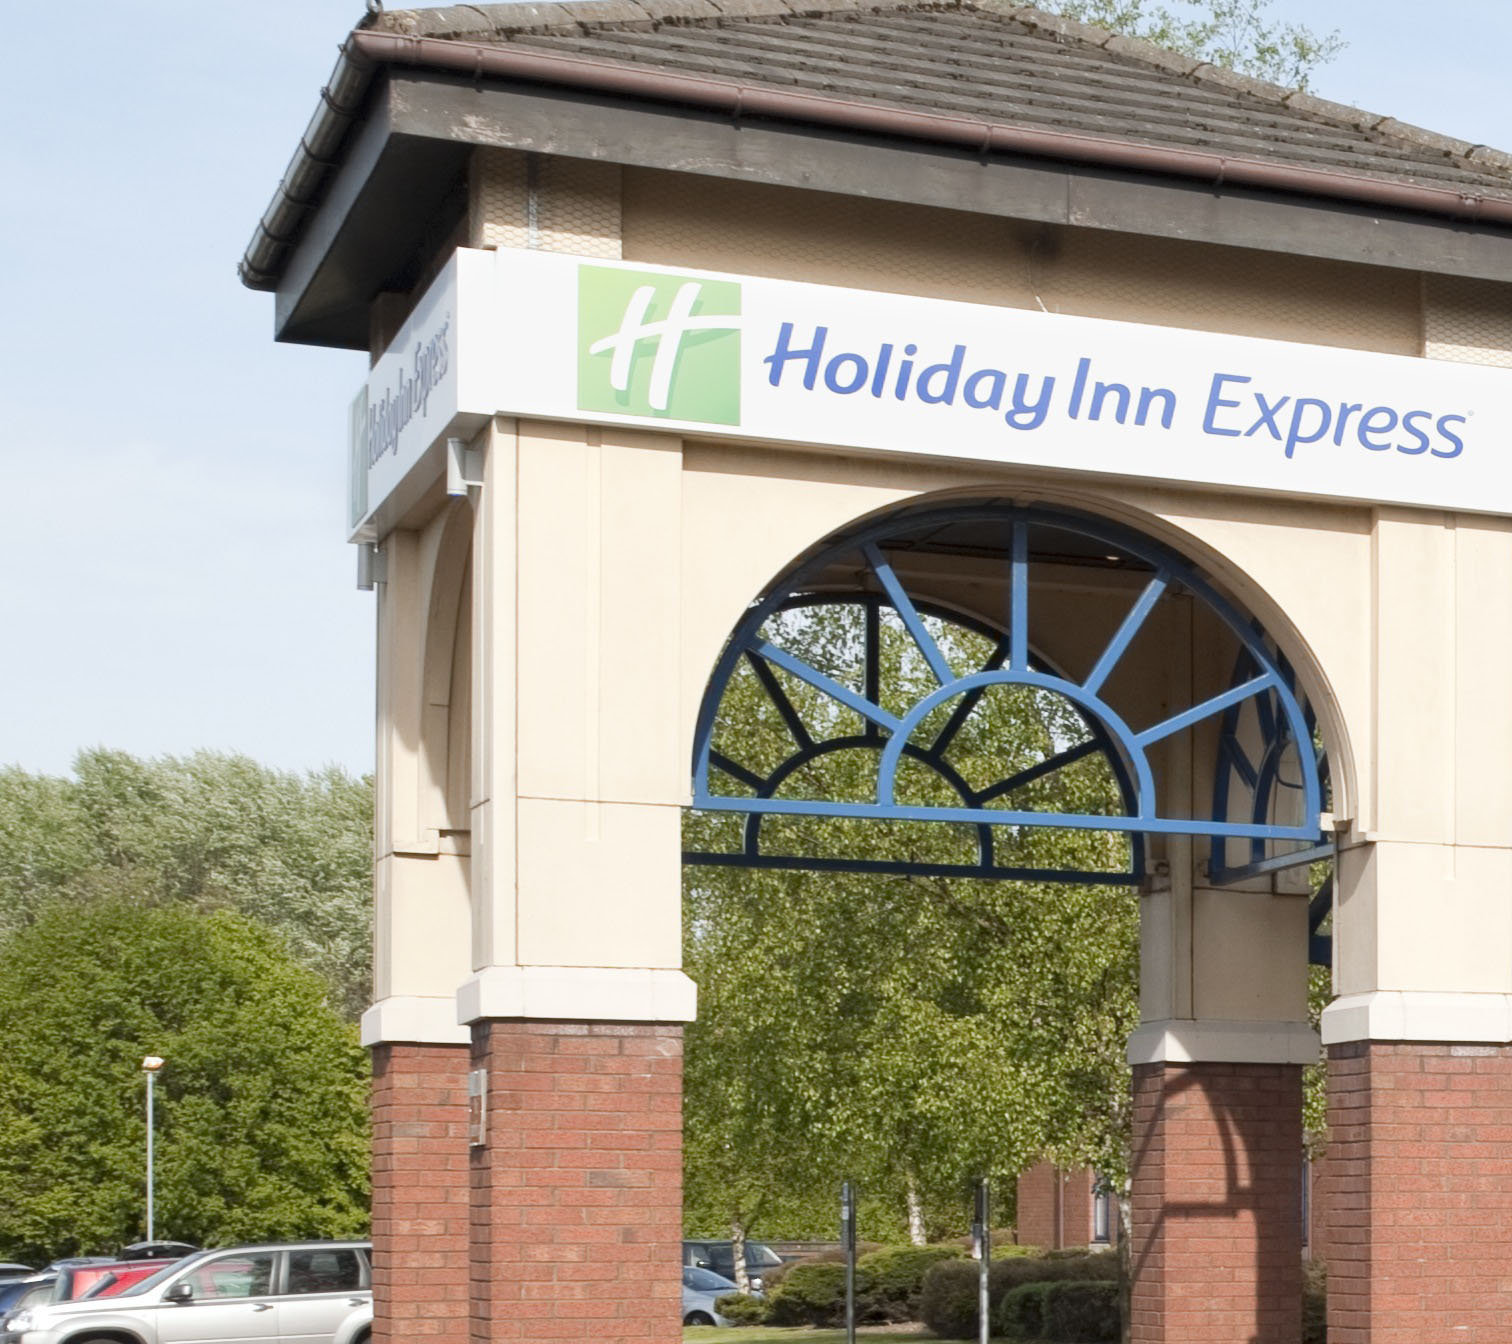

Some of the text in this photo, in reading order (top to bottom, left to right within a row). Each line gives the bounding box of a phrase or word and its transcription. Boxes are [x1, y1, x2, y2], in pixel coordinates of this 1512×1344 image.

[763, 321, 1467, 459] Holiday Inn Express
